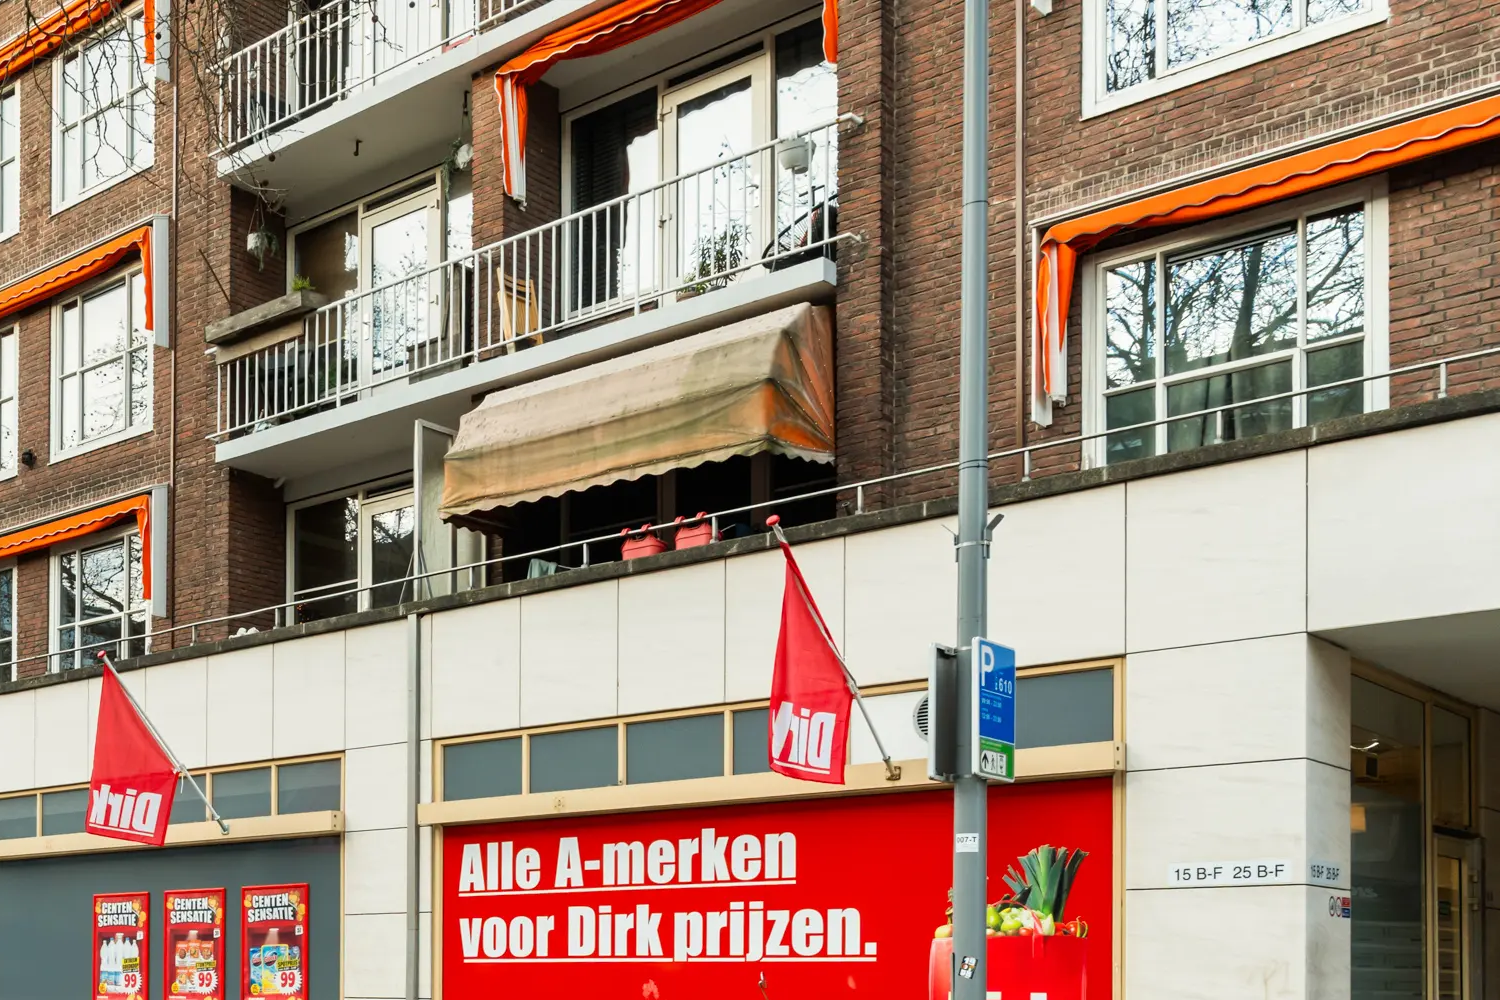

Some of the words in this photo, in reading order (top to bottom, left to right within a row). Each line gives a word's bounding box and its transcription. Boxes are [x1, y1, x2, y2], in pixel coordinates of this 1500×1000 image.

[981, 644, 994, 687] P
[998, 678, 1012, 694] 610
[459, 841, 541, 892] Alle
[554, 828, 797, 888] A-merken
[1174, 868, 1191, 881] 15
[1196, 866, 1223, 880] B-F
[1232, 865, 1252, 879] 25
[1257, 864, 1285, 878] B-F
[102, 901, 133, 914] CENTEN
[174, 897, 209, 910] CENTEN
[252, 893, 289, 908] CENTEN
[97, 913, 137, 927] SENSATIE
[170, 910, 213, 924] SENSATIE
[247, 906, 295, 923] SENSATIE
[459, 914, 555, 958] voor
[567, 904, 664, 957] Dirk
[673, 901, 878, 962] prijzen.
[124, 973, 137, 988] 99
[198, 972, 213, 988] 99
[280, 971, 296, 988] 99
